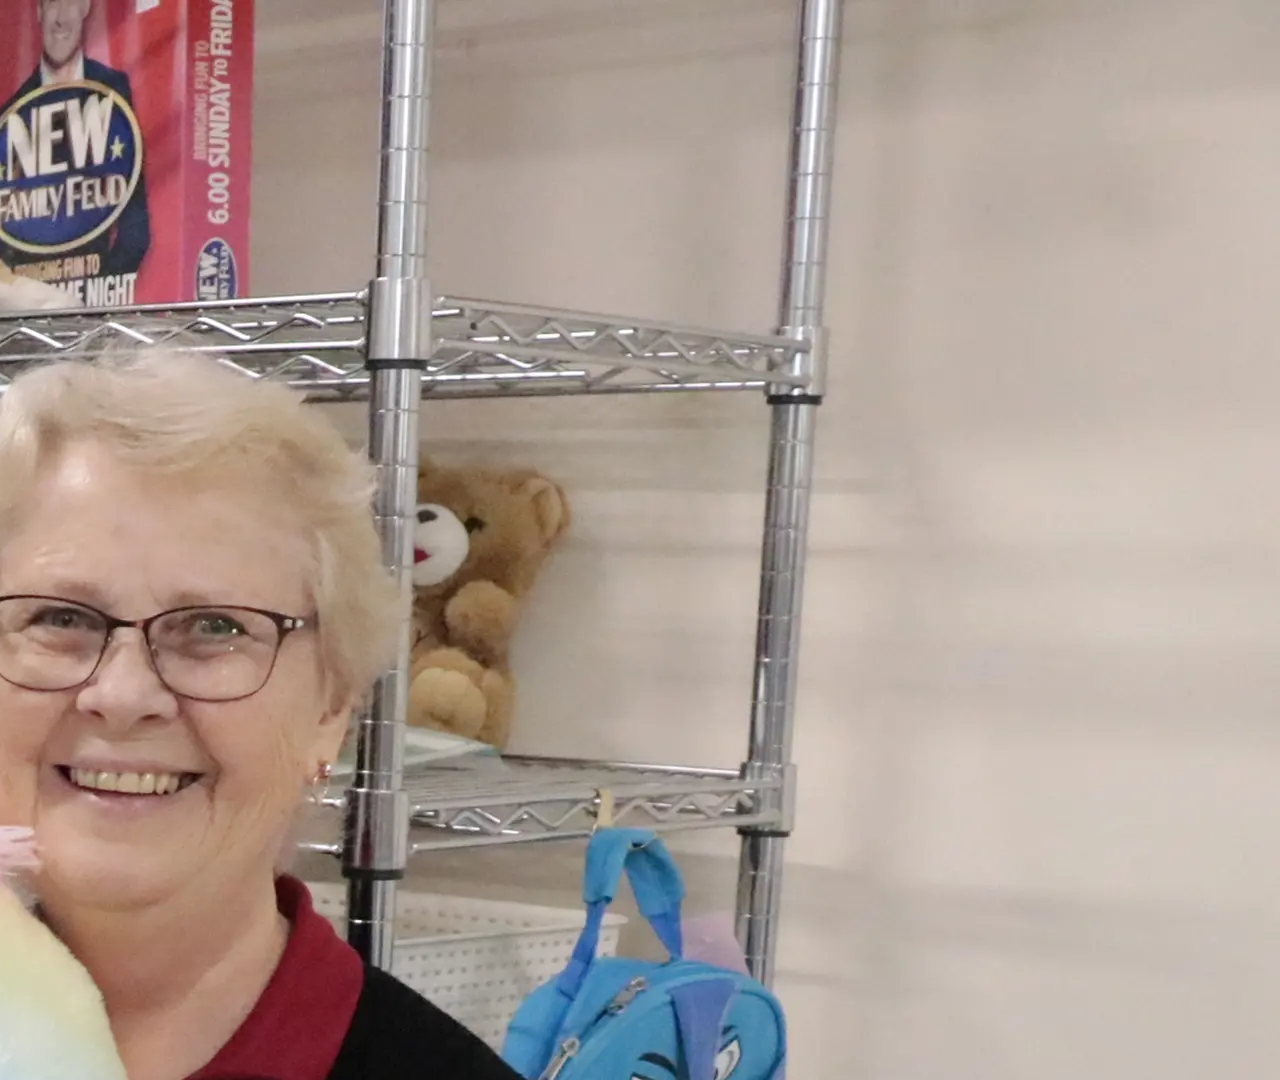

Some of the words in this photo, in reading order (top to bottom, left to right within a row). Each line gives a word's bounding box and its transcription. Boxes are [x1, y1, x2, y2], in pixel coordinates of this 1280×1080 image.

[213, 58, 228, 76] TO
[6, 92, 115, 182] NEW
[208, 77, 231, 168] SUNDAY
[65, 173, 129, 219] FEUD
[208, 172, 230, 225] 6.00
[86, 272, 137, 307] NIGHT
